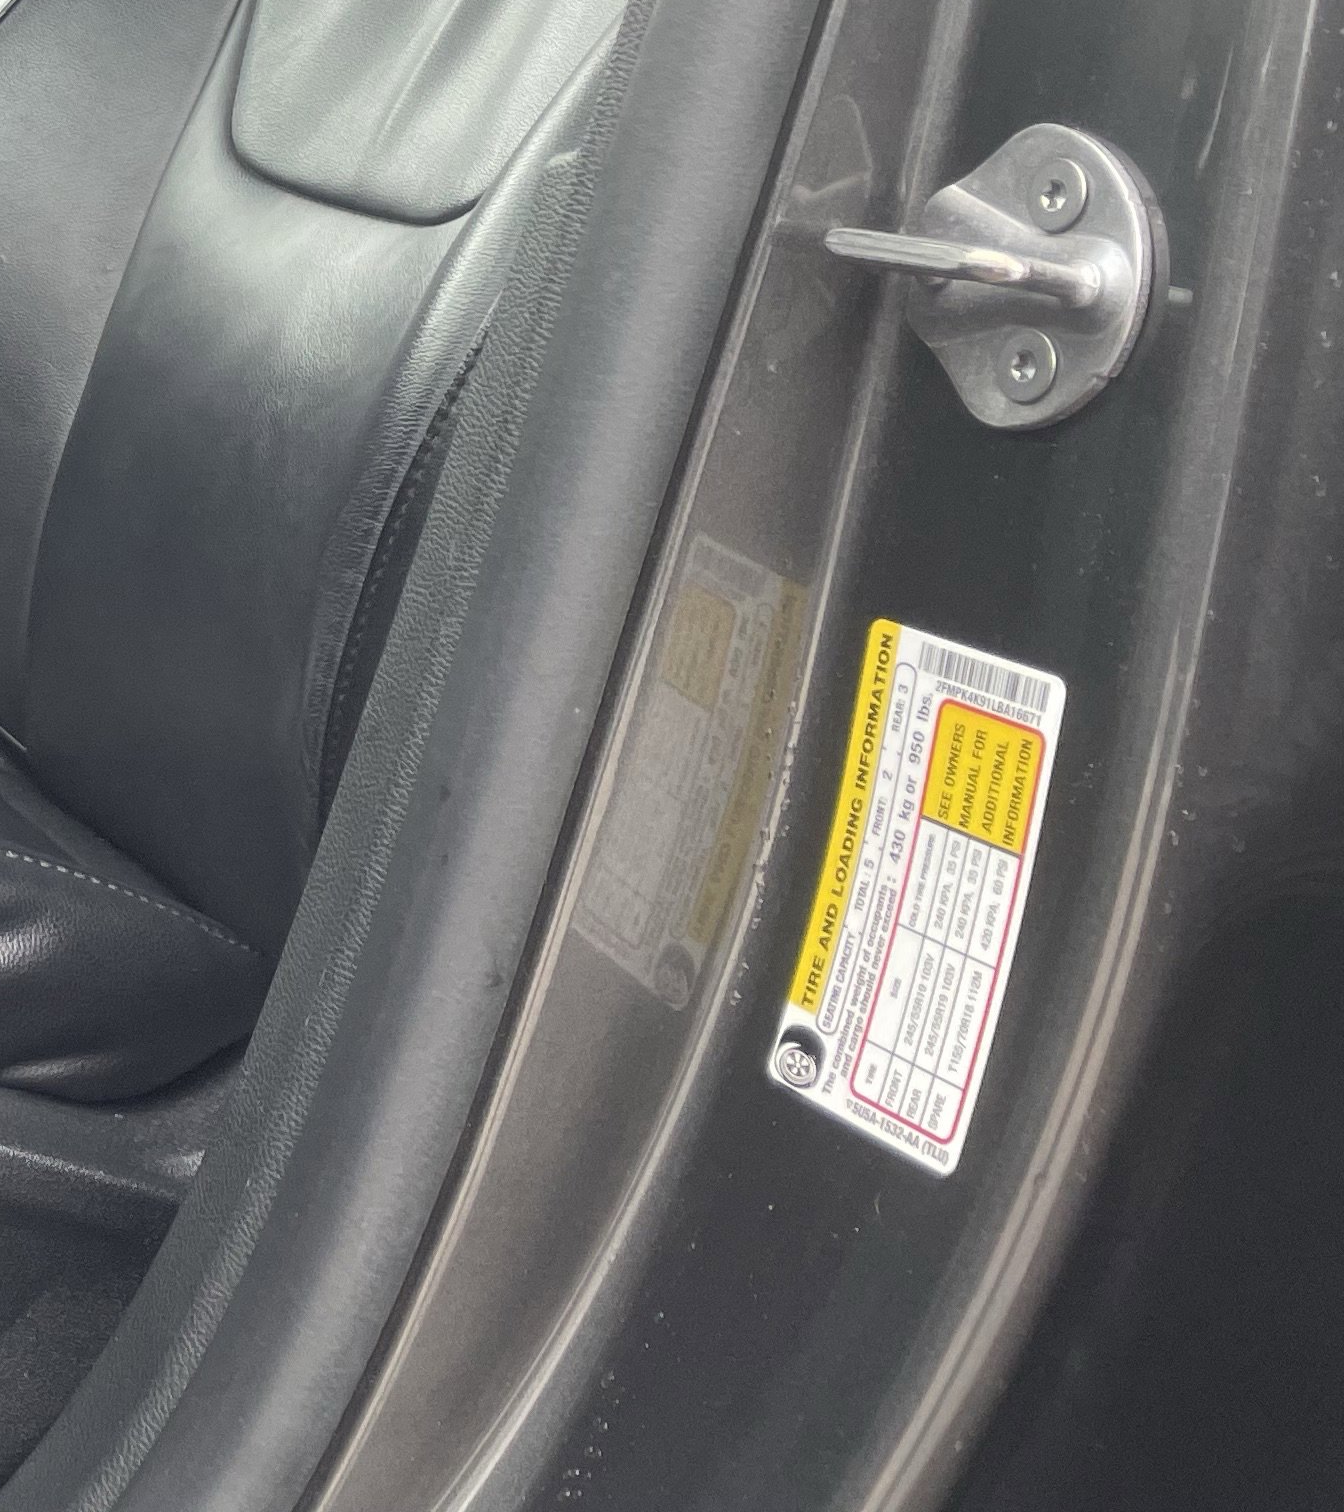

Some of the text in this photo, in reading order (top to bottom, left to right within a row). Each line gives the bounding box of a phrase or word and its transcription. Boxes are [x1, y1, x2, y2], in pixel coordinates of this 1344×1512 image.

[916, 690, 933, 722] lbs.
[909, 730, 925, 764] 950
[905, 774, 917, 793] or
[938, 724, 965, 819] SEE OWNERS
[959, 729, 988, 829] MANUAL FOR
[981, 741, 1009, 835] ADDITIONAL
[1003, 739, 1033, 846] INFORMATION
[801, 633, 893, 1008] TIRE AND LOADING INFORMATION
[899, 799, 915, 821] kg
[821, 984, 841, 1028] SEATING
[835, 931, 856, 983] CAPACITY
[864, 857, 875, 869] 5
[882, 769, 893, 781] 2
[891, 698, 905, 732] REAR:
[898, 683, 908, 694] 3
[890, 829, 906, 864] 430
[879, 888, 897, 932] exceed
[870, 934, 886, 969] never
[822, 883, 889, 1095] The combined weight of occupants
[857, 971, 876, 1013] should
[847, 1015, 866, 1052] cargo
[839, 1053, 852, 1077] and
